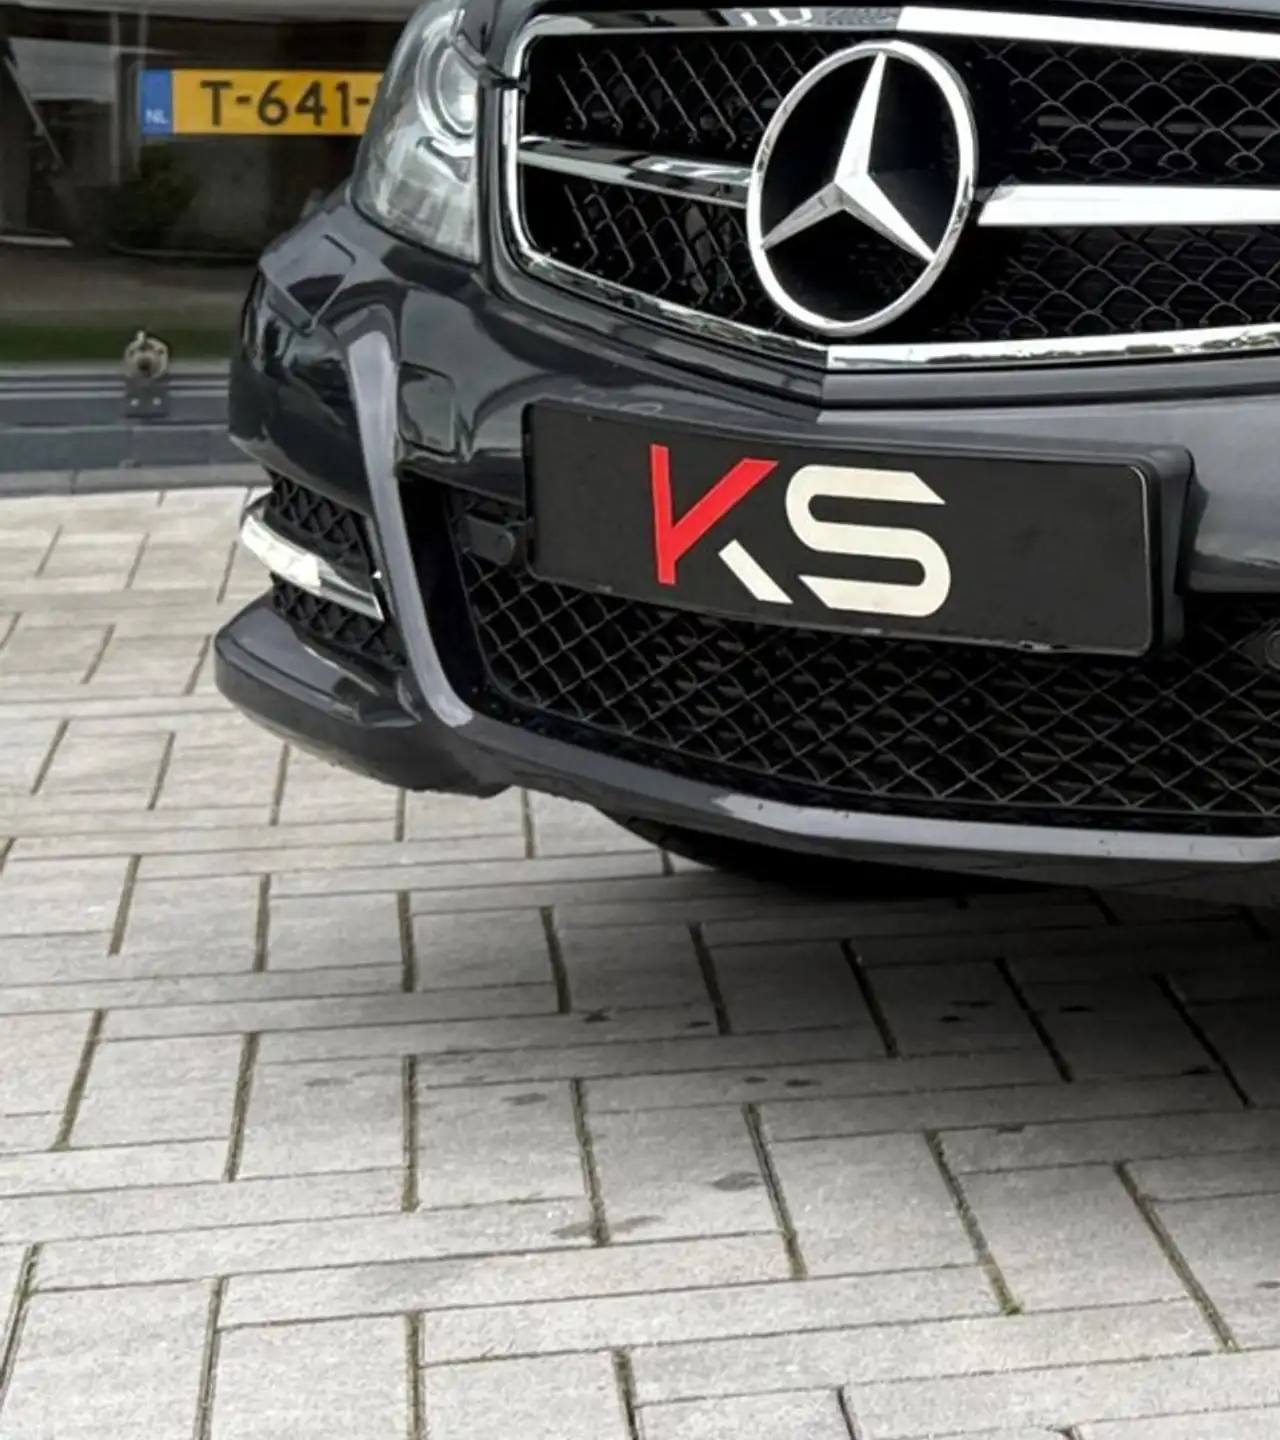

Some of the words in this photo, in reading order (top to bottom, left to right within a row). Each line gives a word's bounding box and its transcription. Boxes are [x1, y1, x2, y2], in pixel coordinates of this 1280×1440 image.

[144, 107, 169, 126] NL
[200, 79, 381, 127] T-641-
[650, 443, 951, 618] KS
